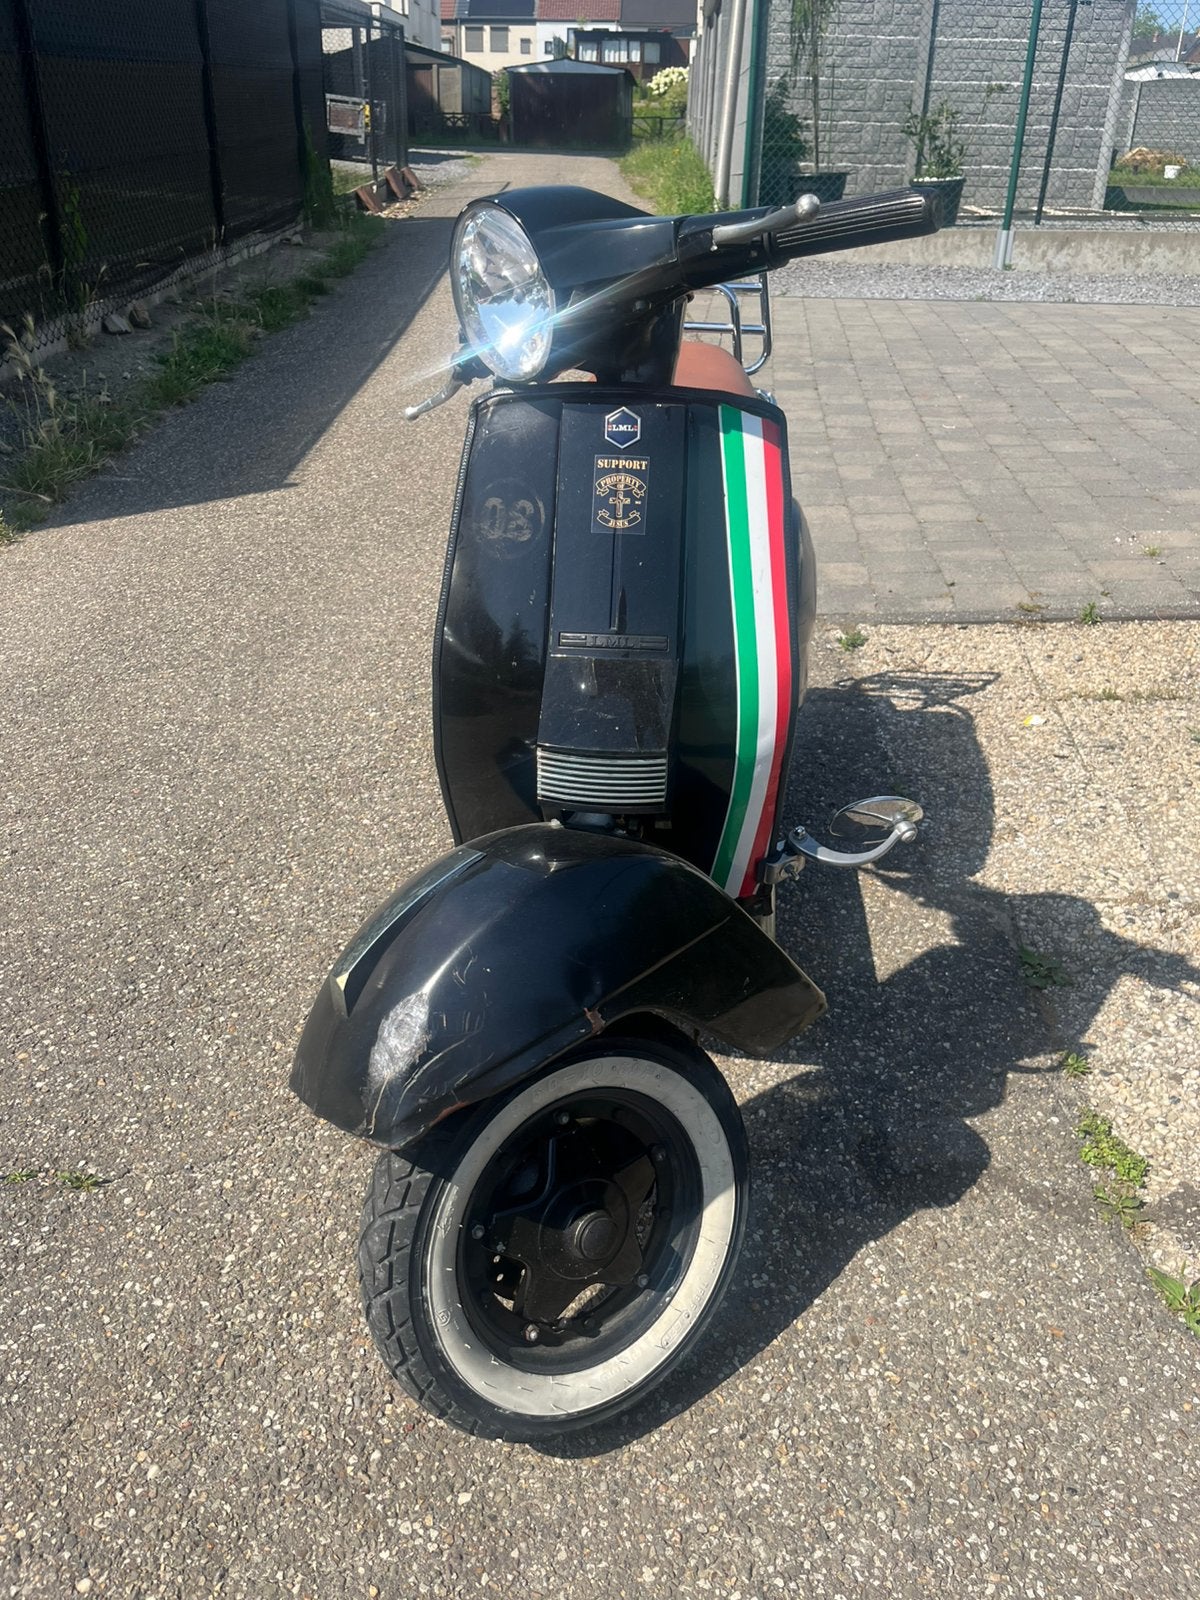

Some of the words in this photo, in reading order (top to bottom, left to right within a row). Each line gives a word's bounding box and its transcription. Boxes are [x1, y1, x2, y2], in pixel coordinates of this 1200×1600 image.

[612, 424, 634, 432] LML
[597, 459, 648, 470] SUPPORT
[600, 475, 641, 488] PROPERTY
[591, 635, 636, 648] LML
